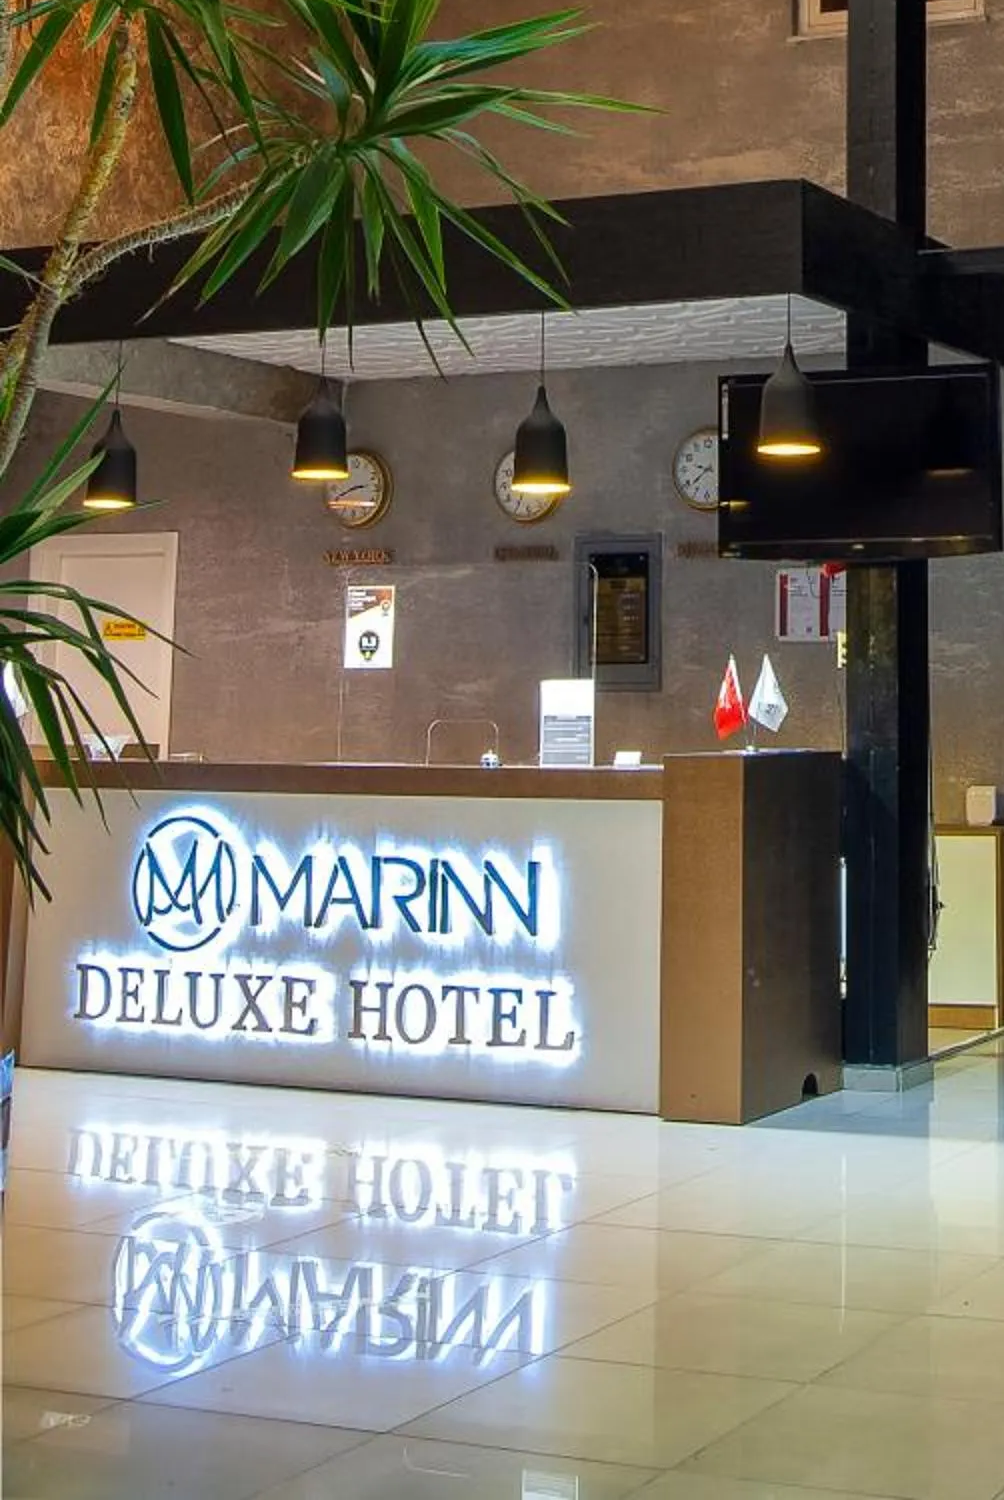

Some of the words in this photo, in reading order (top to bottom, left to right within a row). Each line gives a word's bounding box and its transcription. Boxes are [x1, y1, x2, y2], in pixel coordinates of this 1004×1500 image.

[251, 855, 542, 937] MARINN
[73, 963, 318, 1036] DELUXE
[347, 980, 576, 1051] HOTEL
